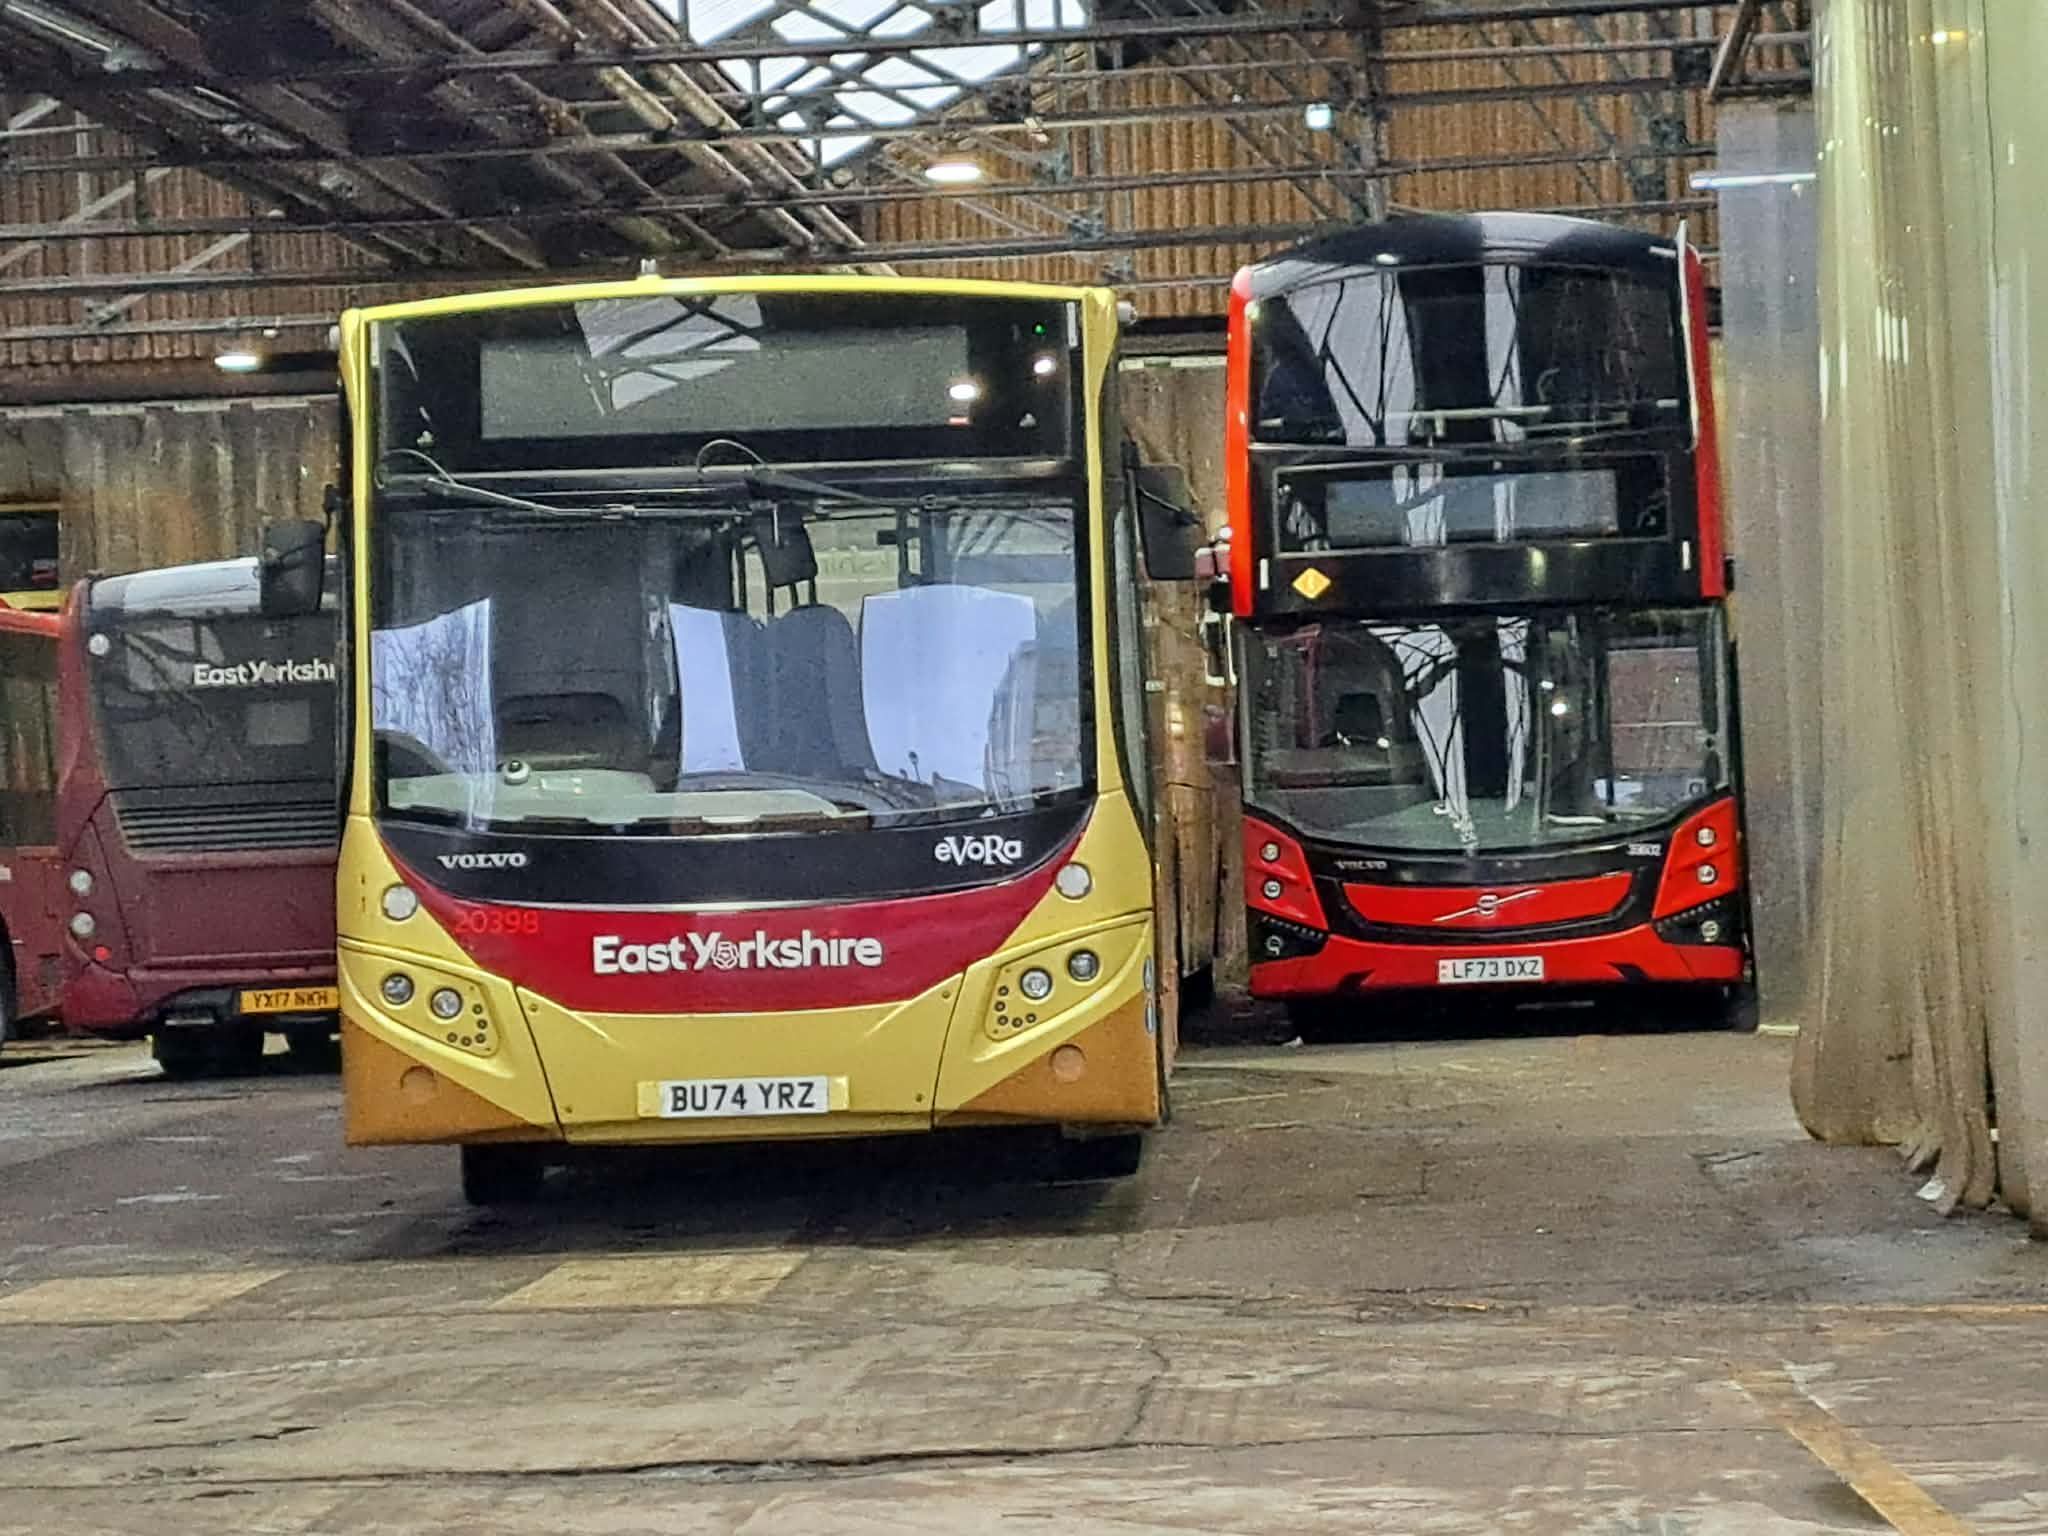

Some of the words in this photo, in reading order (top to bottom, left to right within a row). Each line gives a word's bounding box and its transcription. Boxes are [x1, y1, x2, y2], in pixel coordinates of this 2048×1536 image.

[436, 852, 527, 869] VOLVO
[455, 910, 539, 933] 20398
[1452, 961, 1499, 978] LF73
[1504, 959, 1540, 977] DXZ
[670, 1084, 747, 1112] BU74
[758, 1081, 815, 1109] YRZ
